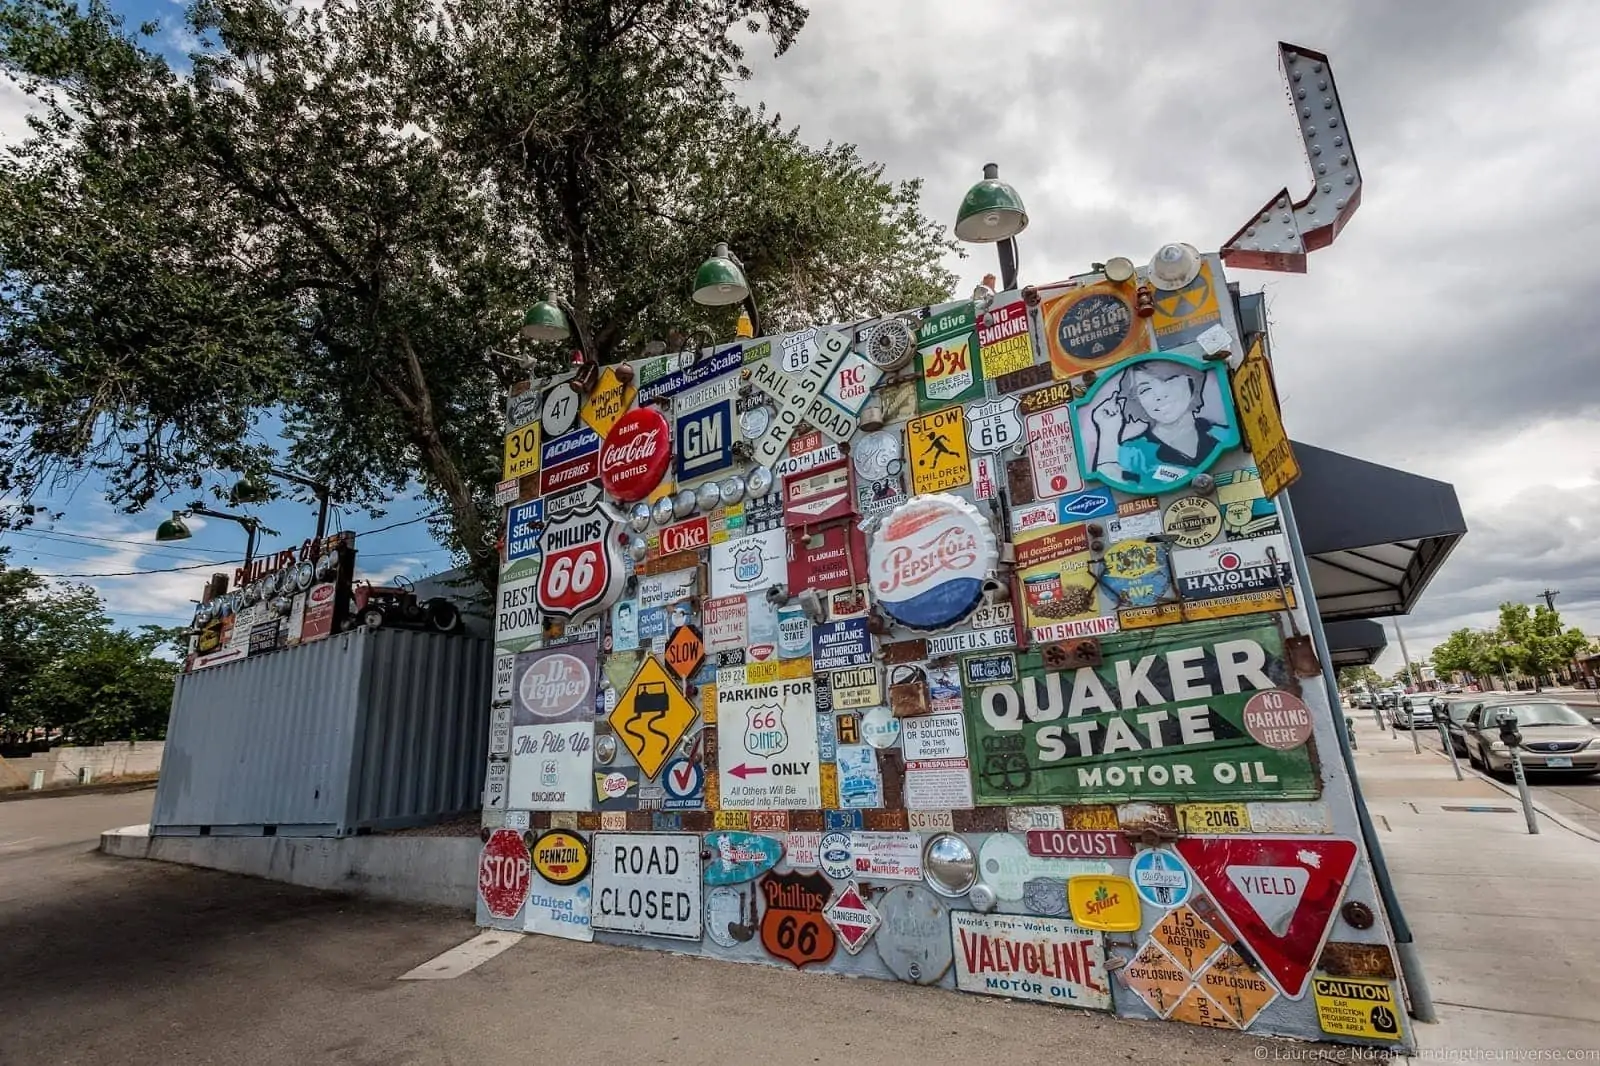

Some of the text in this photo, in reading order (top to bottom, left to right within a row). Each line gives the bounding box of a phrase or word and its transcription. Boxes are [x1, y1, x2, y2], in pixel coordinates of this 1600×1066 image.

[921, 314, 966, 337] We Give
[992, 309, 1008, 324] NO
[1062, 307, 1131, 339] MISSION
[979, 316, 1028, 346] SMOKING
[1070, 324, 1120, 347] BEVERAGES
[983, 335, 1029, 359] CAUTION
[710, 350, 742, 373] Scales
[790, 349, 809, 368] 66
[839, 364, 866, 388] RC
[928, 372, 970, 390] GREEN
[590, 384, 624, 407] WINDING
[839, 384, 865, 400] Cola
[929, 378, 972, 396] STAMPS
[1035, 384, 1070, 405] 23-042
[754, 363, 792, 398] RAIL
[807, 399, 850, 438] ROAD
[762, 338, 842, 456] CROSSING
[551, 396, 570, 419] 47
[595, 403, 620, 421] ROAD
[619, 421, 639, 436] DRINK
[912, 410, 959, 435] SLOW
[1042, 413, 1054, 426] NO
[683, 410, 722, 460] GM
[981, 423, 1008, 447] 66
[1030, 421, 1070, 441] PARKING
[510, 428, 534, 459] 30
[545, 429, 599, 460] ACDelco
[602, 427, 661, 472] Coca-Cola
[510, 457, 534, 474] M.P.H.
[548, 461, 590, 486] BATTERIES
[611, 463, 648, 483] IN BOTTLES
[916, 465, 967, 484] CHILDREN
[920, 475, 966, 493] AT PLAY
[550, 491, 586, 512] ONE WAY
[1118, 498, 1159, 515] FOR SALE
[1170, 497, 1209, 514] WE USE
[517, 505, 538, 521] FULL
[1167, 515, 1217, 532] CHEVROLET
[547, 520, 602, 552] PHILLIPS
[662, 525, 705, 553] Coke
[1179, 531, 1213, 547] PARTS
[740, 550, 756, 565] 66
[807, 549, 845, 563] FLAMMABLE
[547, 550, 597, 599] 66
[1186, 564, 1286, 590] HAVOLINE
[1209, 579, 1265, 593] MOTOR OIL
[502, 585, 536, 610] REST
[642, 588, 687, 607] travel guide
[498, 608, 540, 632] ROOM
[704, 606, 746, 624] NO STOPPING
[976, 605, 1010, 621] 69-767
[709, 622, 744, 635] ANY TIME
[780, 620, 808, 632] QUAKER
[834, 621, 846, 633] NO
[1037, 617, 1116, 641] NO SMOKING
[783, 630, 805, 641] STATE
[818, 628, 864, 644] ADMITTANCE
[933, 630, 1008, 652] ROUTE U.S. 66
[669, 641, 699, 664] SLOW
[821, 643, 864, 659] AUTHORIZED
[497, 657, 513, 671] ONE
[814, 653, 871, 669] PERSONNEL ONLY
[497, 671, 512, 685] WAY
[546, 659, 573, 684] Dr
[834, 668, 877, 688] CAUTION
[527, 674, 584, 708] Pepper
[719, 682, 812, 703] PARKING FOR
[980, 639, 1277, 731] QUAKER
[1263, 693, 1283, 710] NO
[752, 710, 776, 729] 66
[906, 718, 958, 730] NO LOITERING
[1247, 707, 1309, 730] PARKING
[862, 720, 899, 736] Gulf
[906, 728, 960, 739] OR SOLICITING
[1036, 704, 1215, 762] STATE
[1263, 727, 1299, 745] HERE
[515, 735, 538, 756] The
[541, 730, 566, 754] Pile
[569, 732, 591, 757] Up
[750, 732, 784, 750] DINER
[919, 747, 950, 756] PROPERTY
[772, 762, 810, 776] ONLY
[918, 760, 967, 768] TRESPASSING
[1078, 762, 1279, 787] MOTOR OIL
[730, 784, 796, 795] All Others Will Be
[722, 797, 807, 807] Pounded Into Flatware
[1204, 810, 1240, 827] 2046
[787, 834, 820, 848] HARD HAT
[822, 833, 851, 849] GENUINE
[1039, 833, 1118, 855] LOCUST
[539, 847, 579, 864] PENNZOIL
[614, 845, 679, 875] ROAD
[795, 852, 814, 863] AREA
[482, 856, 528, 890] STOP
[827, 865, 852, 877] PARTS
[1240, 875, 1296, 896] YIELD
[531, 894, 573, 910] United
[600, 887, 691, 922] CLOSED
[764, 879, 825, 913] Phillips
[1085, 892, 1120, 915] Squirt
[551, 909, 589, 926] Delco
[832, 910, 872, 924] DANGEROUS
[1172, 912, 1194, 928] 1.5
[776, 915, 819, 956] 66
[1162, 925, 1211, 940] BLASTING
[1167, 935, 1206, 949] AGENTS
[959, 927, 1101, 992] VALVOLINE
[1130, 968, 1184, 982] EXPLOSIVES
[1206, 973, 1267, 992] EXPLOSIVES
[986, 978, 1078, 998] MOTOR OIL
[1316, 980, 1390, 1001] CAUTION
[1321, 1006, 1365, 1017] PROTECTION
[1333, 999, 1349, 1007] EAR
[1321, 1014, 1367, 1024] REQUIRED IN
[1327, 1022, 1365, 1032] THIS AREA
